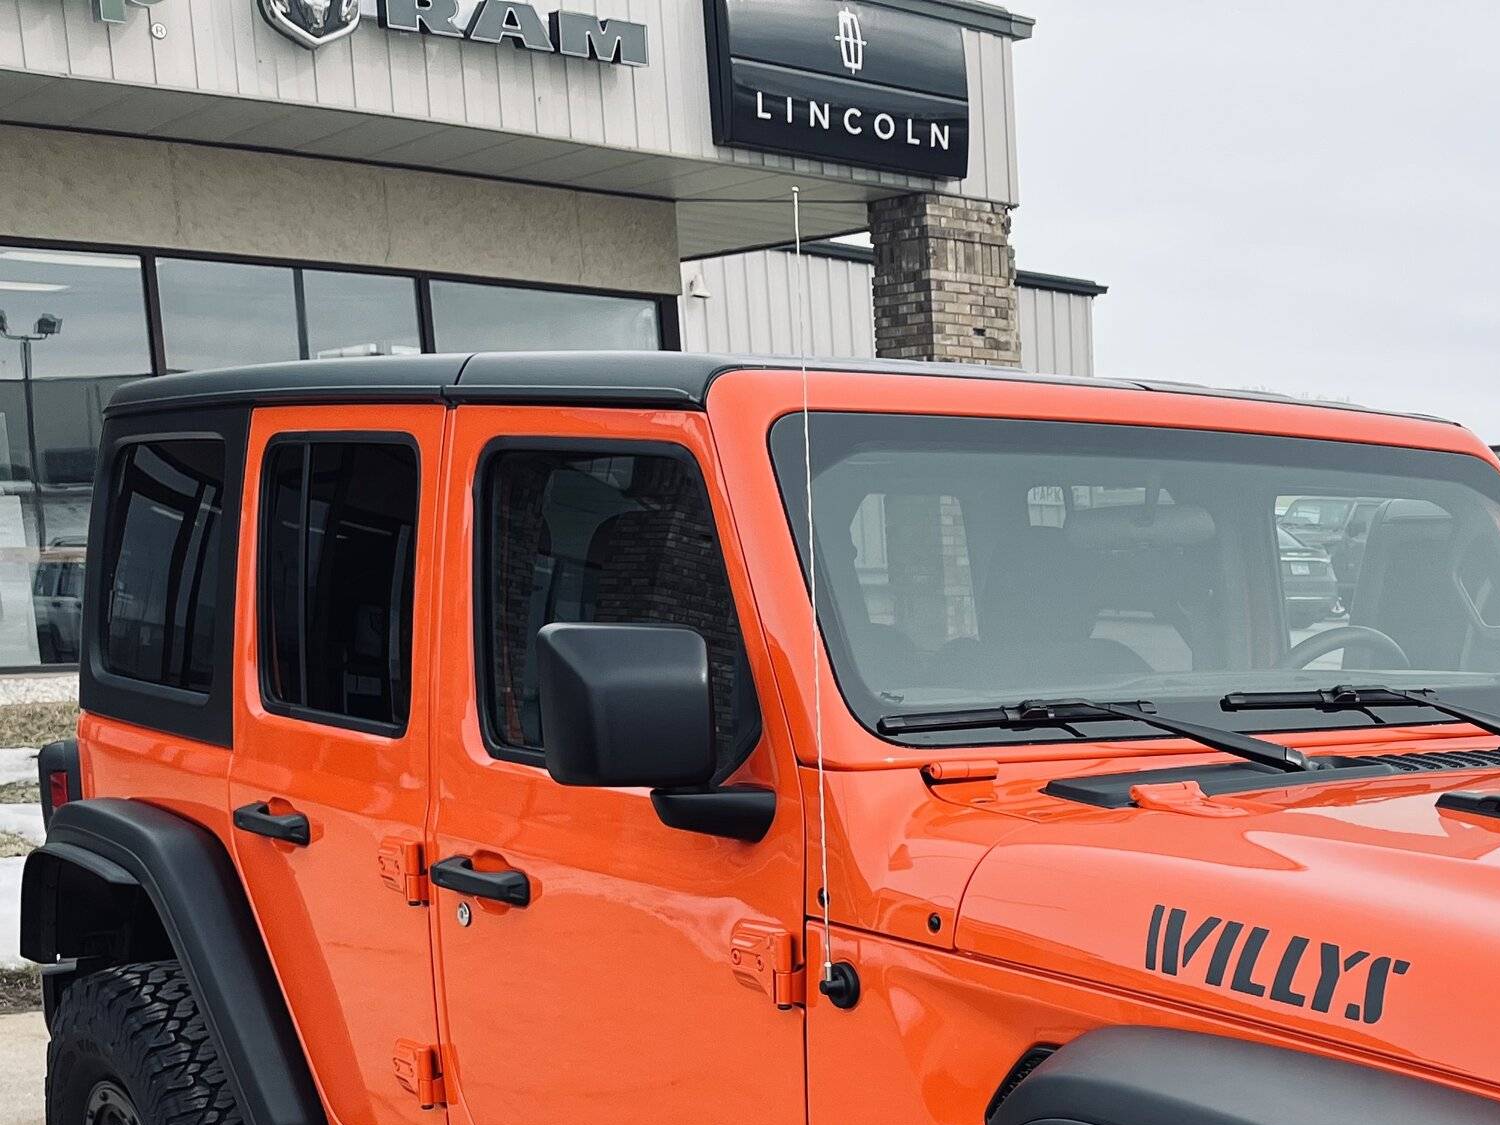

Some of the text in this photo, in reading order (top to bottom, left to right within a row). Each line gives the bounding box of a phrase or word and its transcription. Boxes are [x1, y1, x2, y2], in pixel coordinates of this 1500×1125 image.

[378, 0, 649, 67] RAM
[756, 91, 950, 150] LINCOLN
[1145, 904, 1411, 1024] WILLYS
